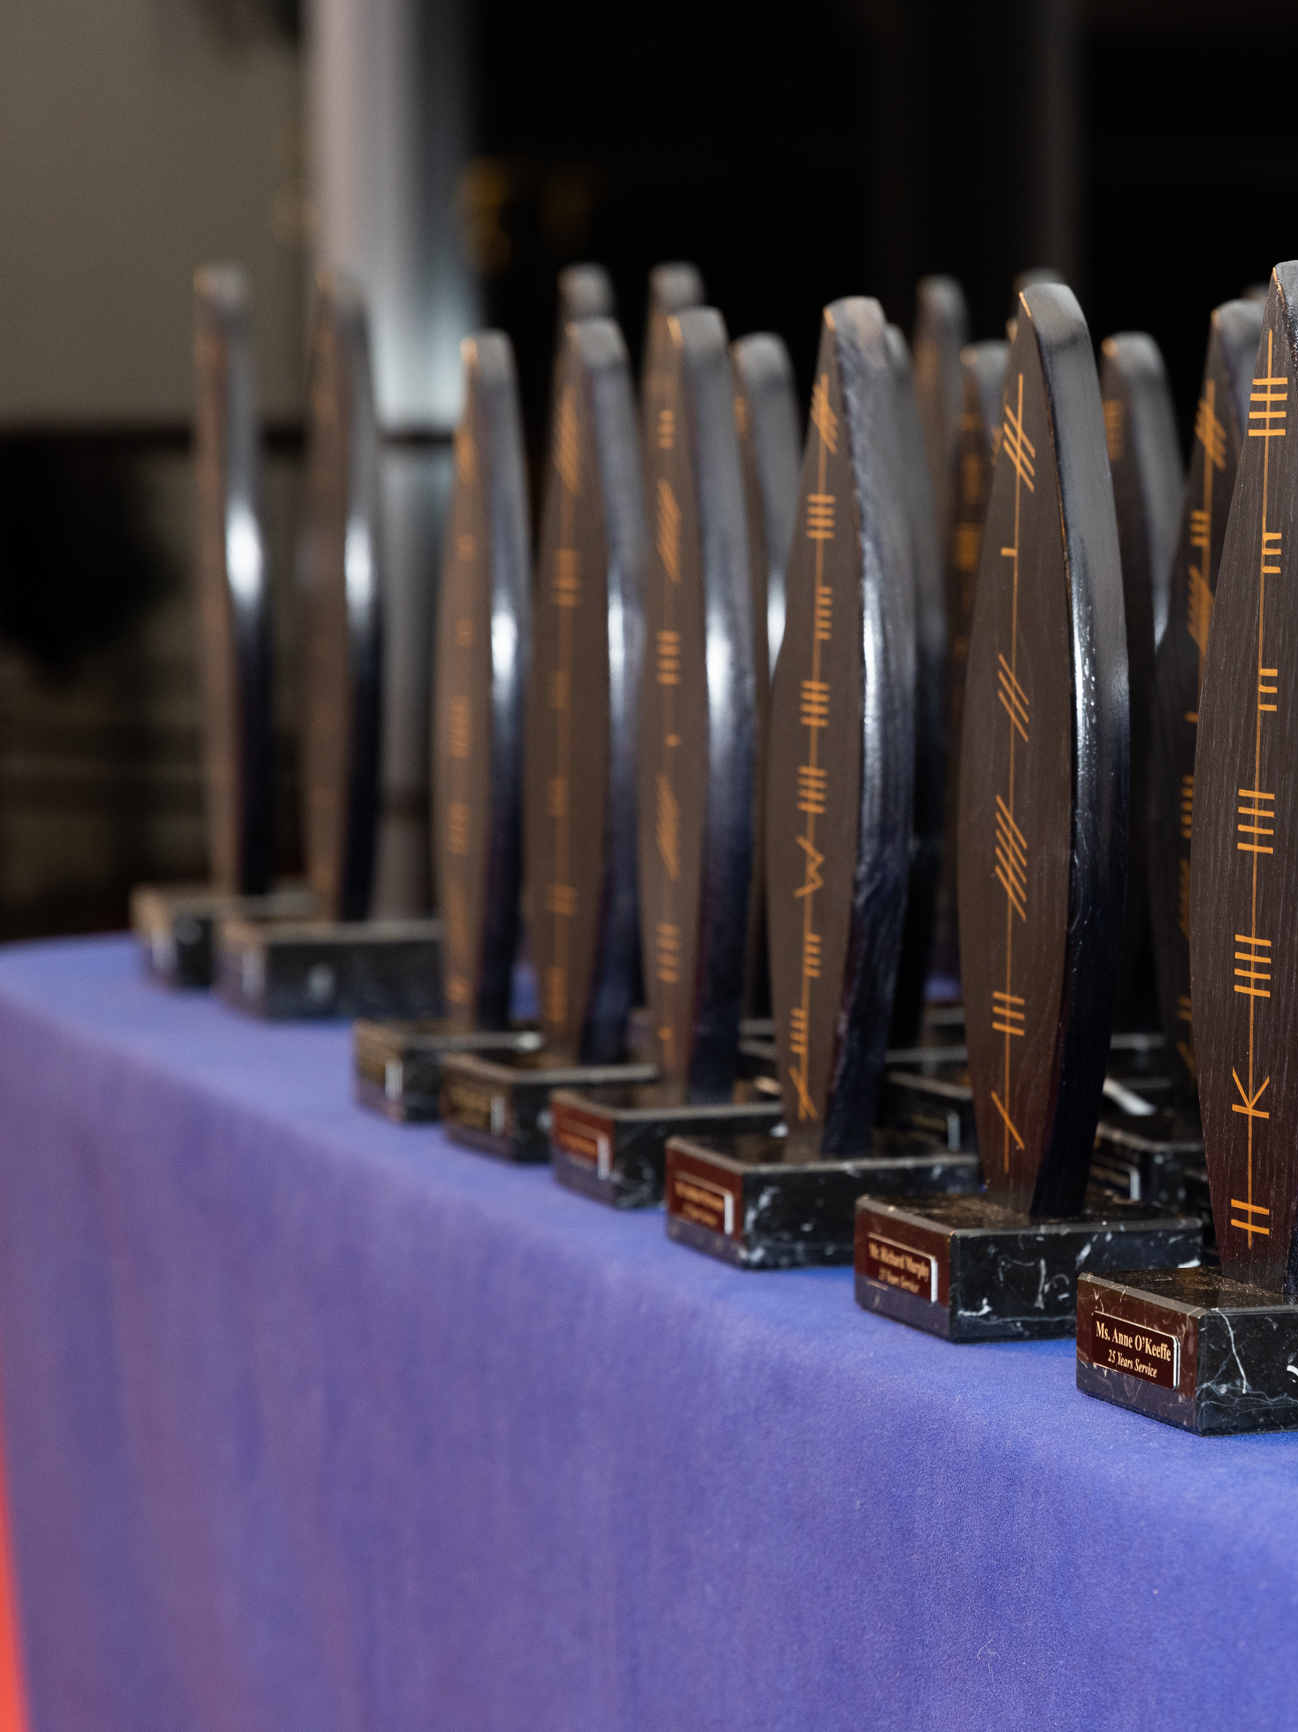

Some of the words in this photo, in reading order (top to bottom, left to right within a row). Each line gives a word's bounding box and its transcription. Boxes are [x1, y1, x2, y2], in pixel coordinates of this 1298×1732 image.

[1095, 1320, 1111, 1341] Ms.
[1112, 1327, 1133, 1349] Anne
[1134, 1334, 1172, 1362] O'Keeffe
[1107, 1348, 1116, 1364] 25
[1117, 1351, 1134, 1370] Years
[1134, 1357, 1158, 1378] Service
